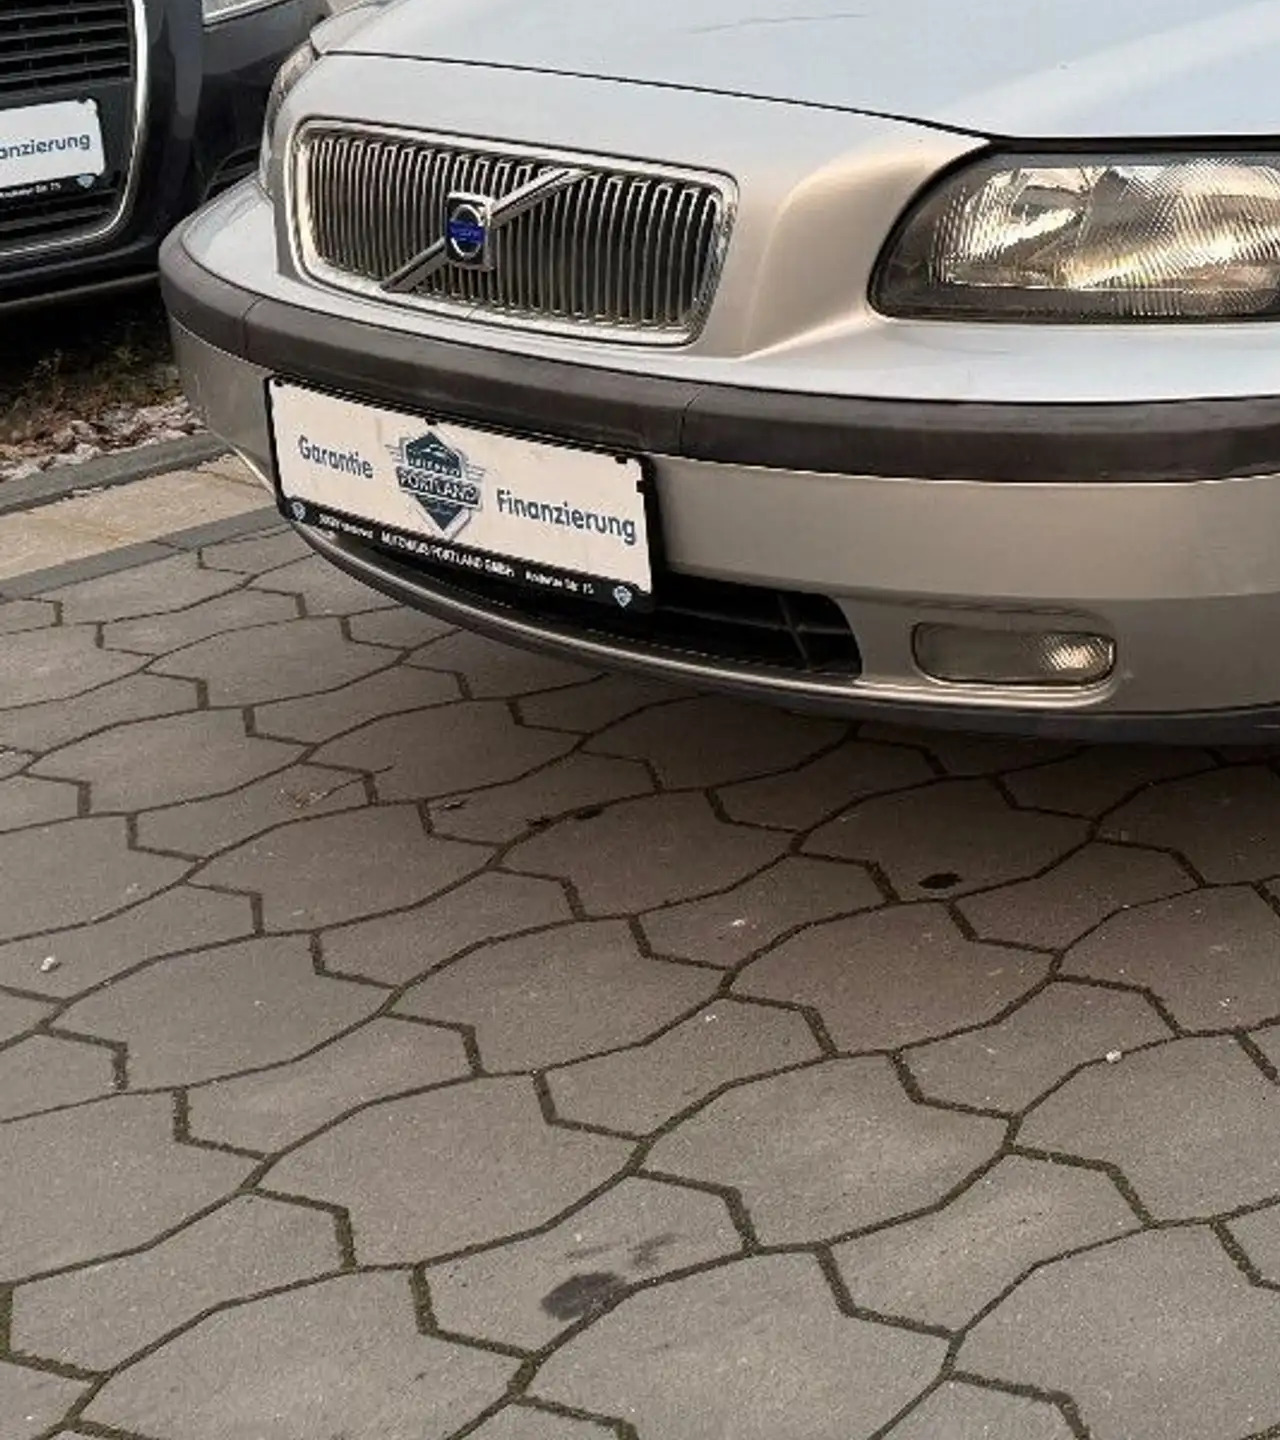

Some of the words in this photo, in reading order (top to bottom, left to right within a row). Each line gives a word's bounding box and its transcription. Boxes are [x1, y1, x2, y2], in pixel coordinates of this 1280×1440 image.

[298, 434, 374, 479] Garantie
[399, 468, 477, 501] PORTLAND
[496, 487, 636, 546] Finanzierung
